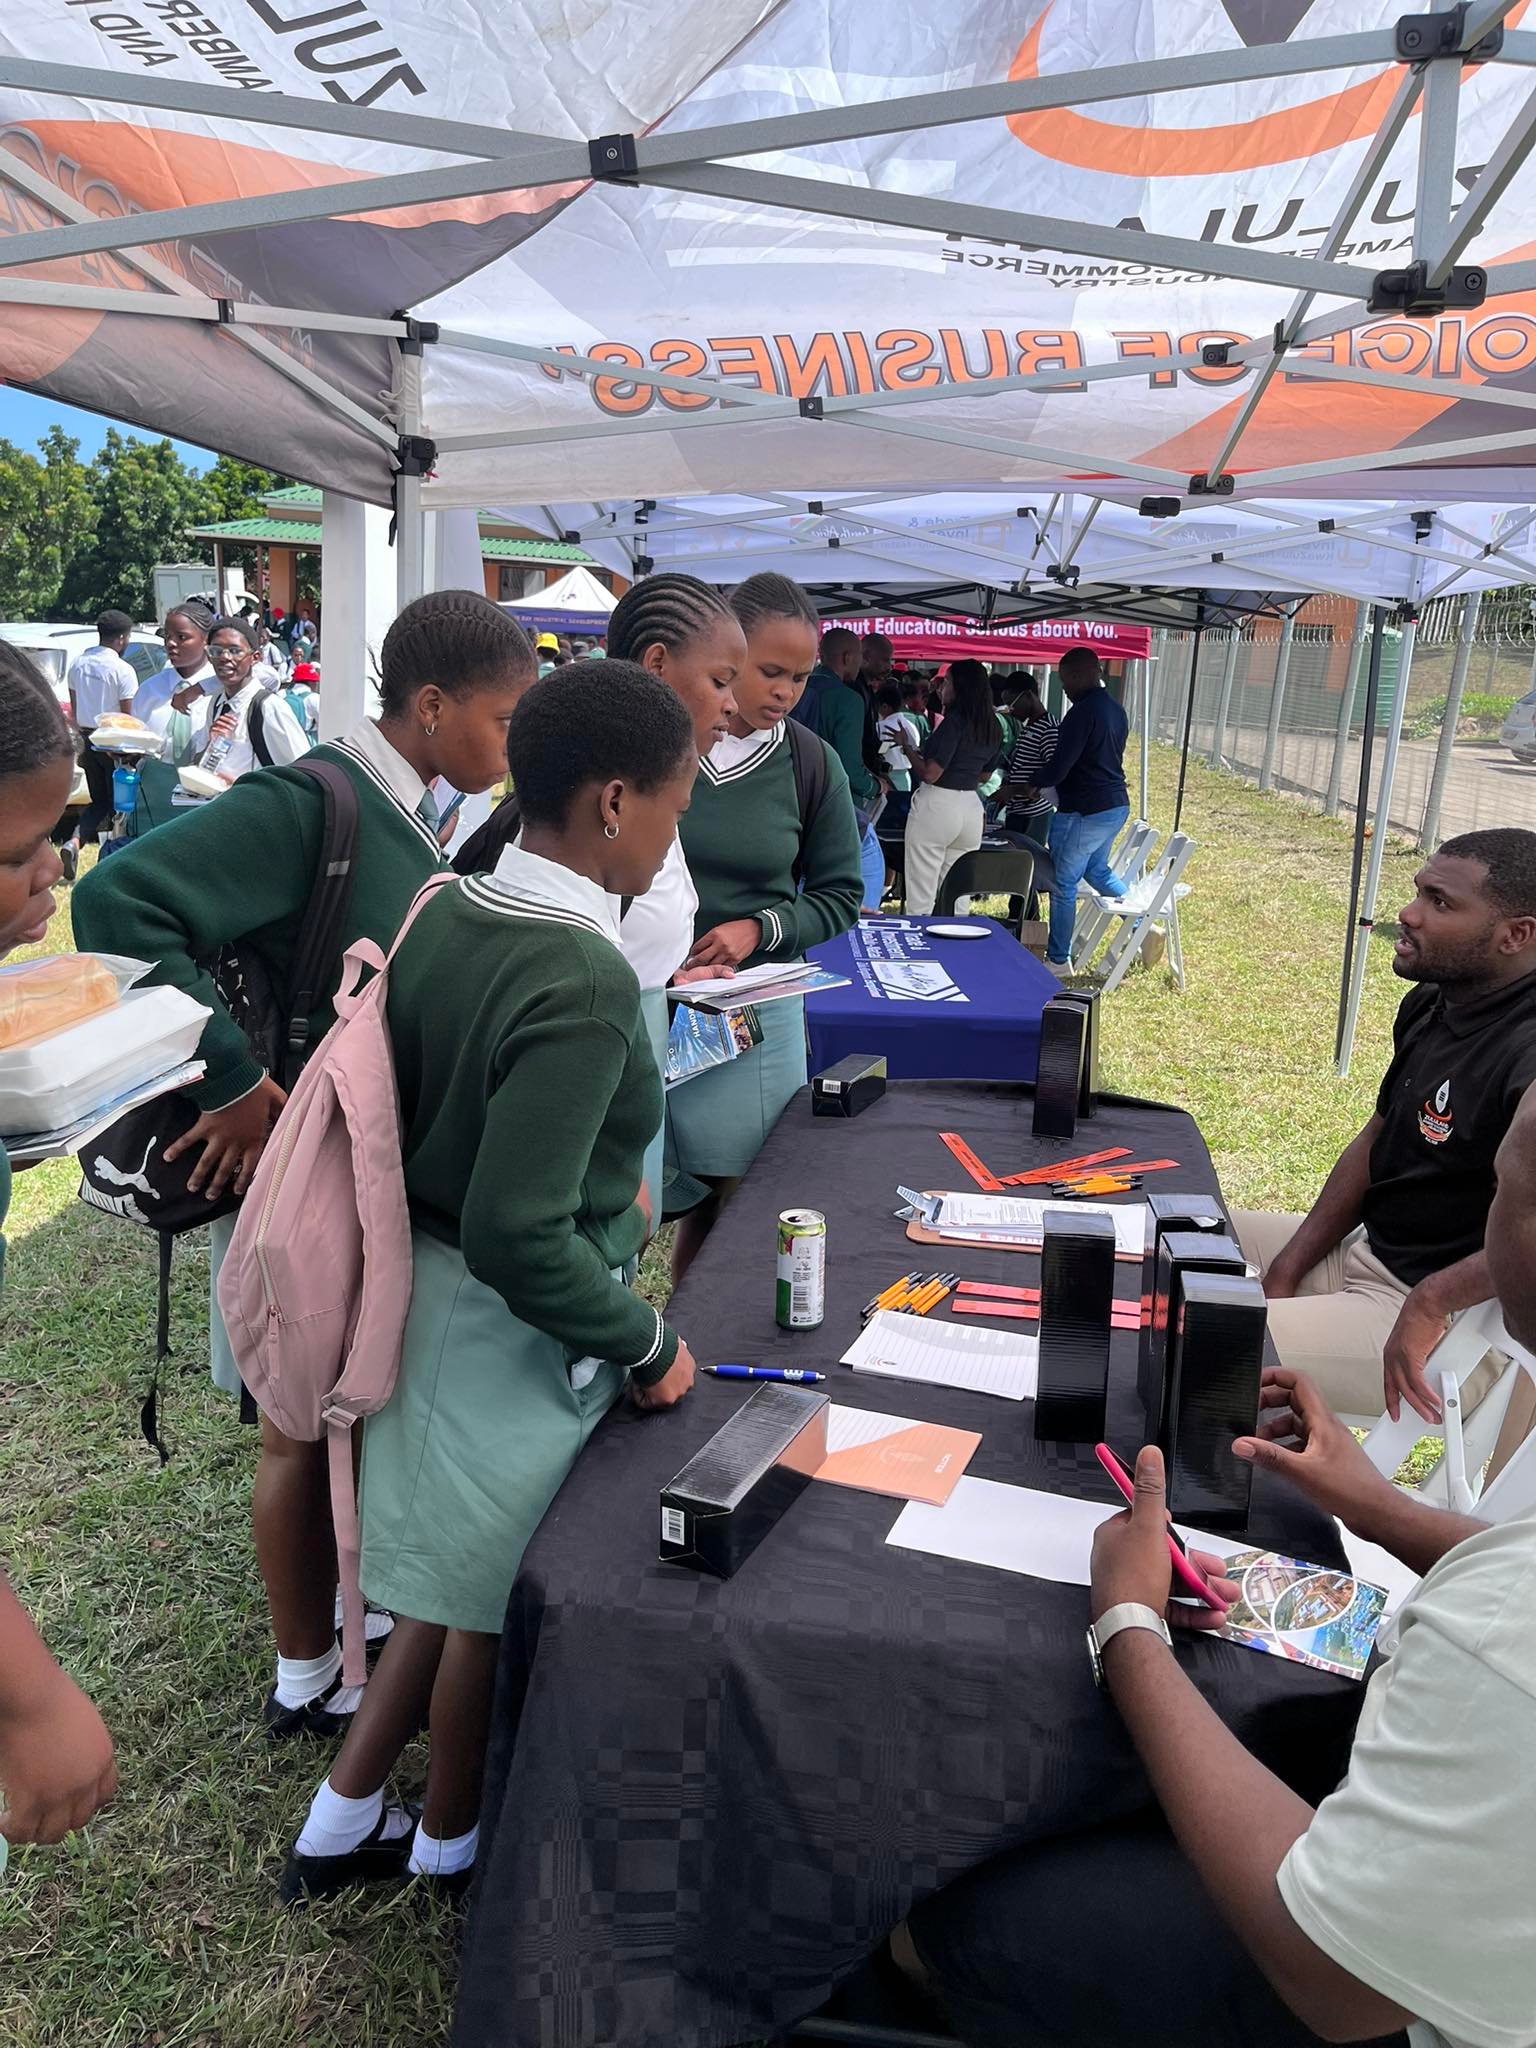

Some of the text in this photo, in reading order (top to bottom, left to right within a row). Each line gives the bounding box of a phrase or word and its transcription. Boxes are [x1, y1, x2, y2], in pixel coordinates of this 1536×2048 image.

[875, 618, 961, 635] Education.
[1032, 620, 1080, 638] about
[1084, 621, 1118, 639] You.
